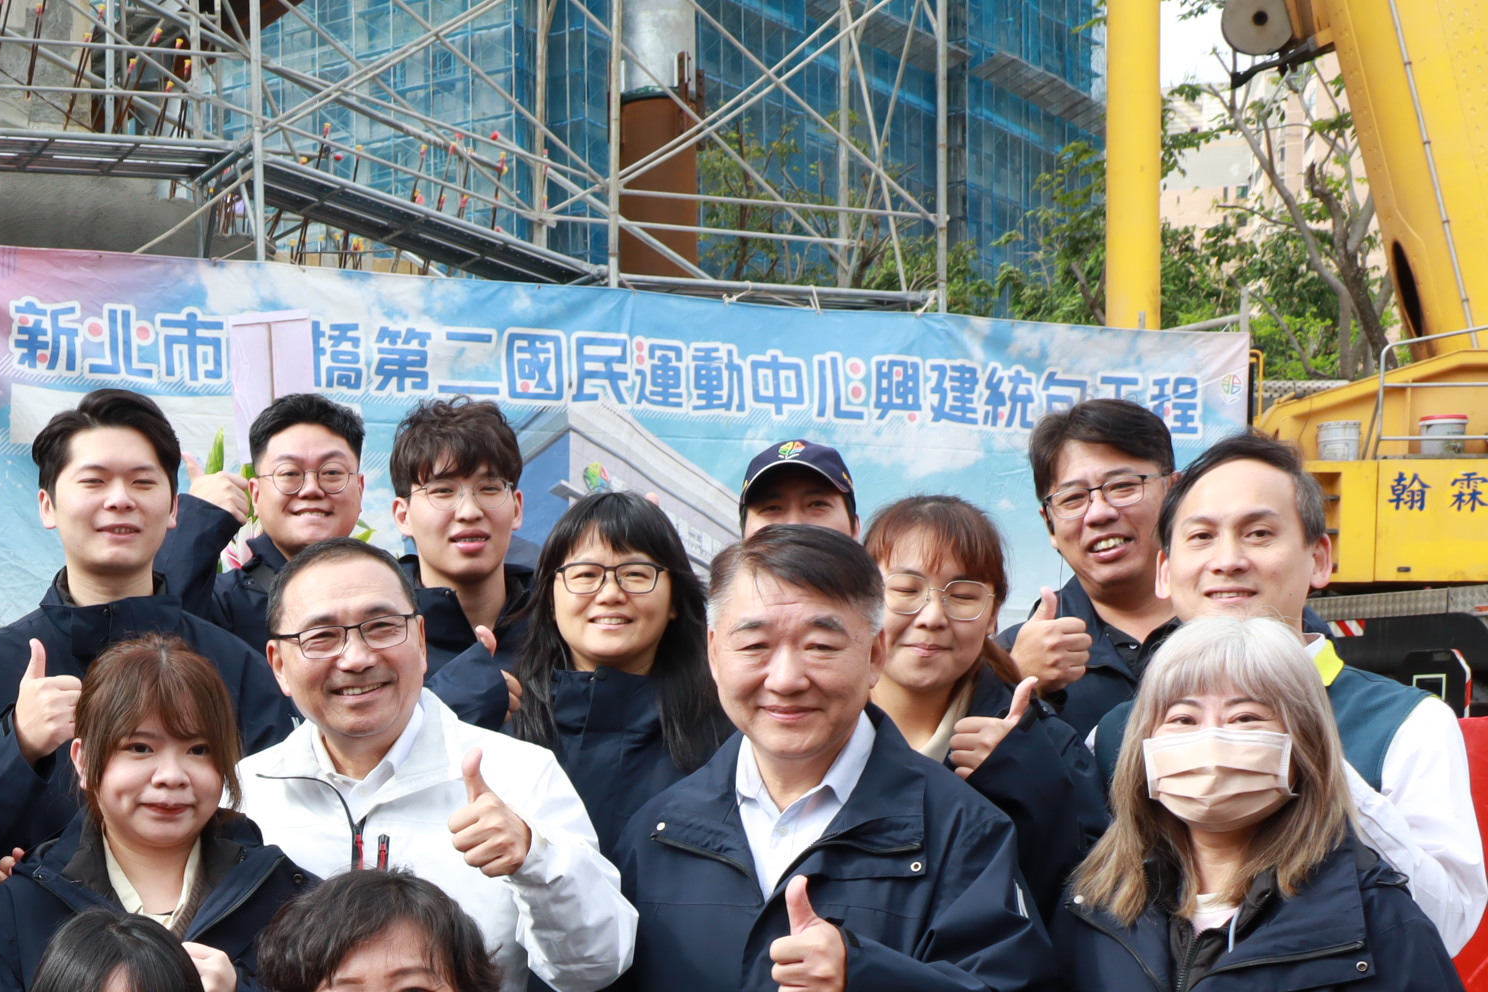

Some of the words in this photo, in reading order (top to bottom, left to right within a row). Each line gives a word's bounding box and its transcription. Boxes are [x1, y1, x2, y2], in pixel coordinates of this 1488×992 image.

[13, 299, 1200, 436] 新北市橋第二國民運動中心興建統包程
